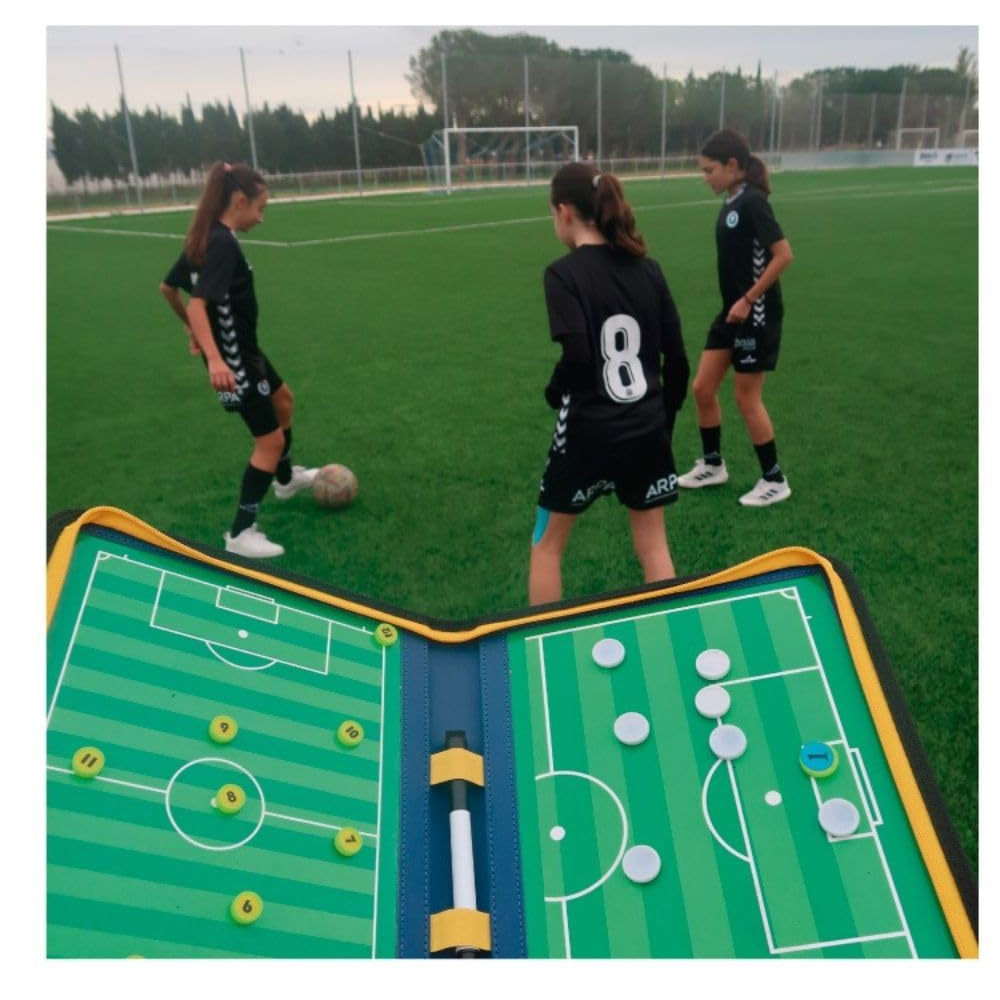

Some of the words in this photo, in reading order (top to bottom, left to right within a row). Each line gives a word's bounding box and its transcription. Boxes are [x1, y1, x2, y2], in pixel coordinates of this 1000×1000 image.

[600, 313, 648, 403] 8
[645, 473, 678, 499] ARP
[220, 721, 230, 733] 9
[345, 725, 360, 739] 10
[80, 752, 99, 768] 11
[807, 750, 829, 762] 1
[226, 790, 237, 803] 8
[344, 834, 357, 844] 7
[242, 899, 253, 914] 6
